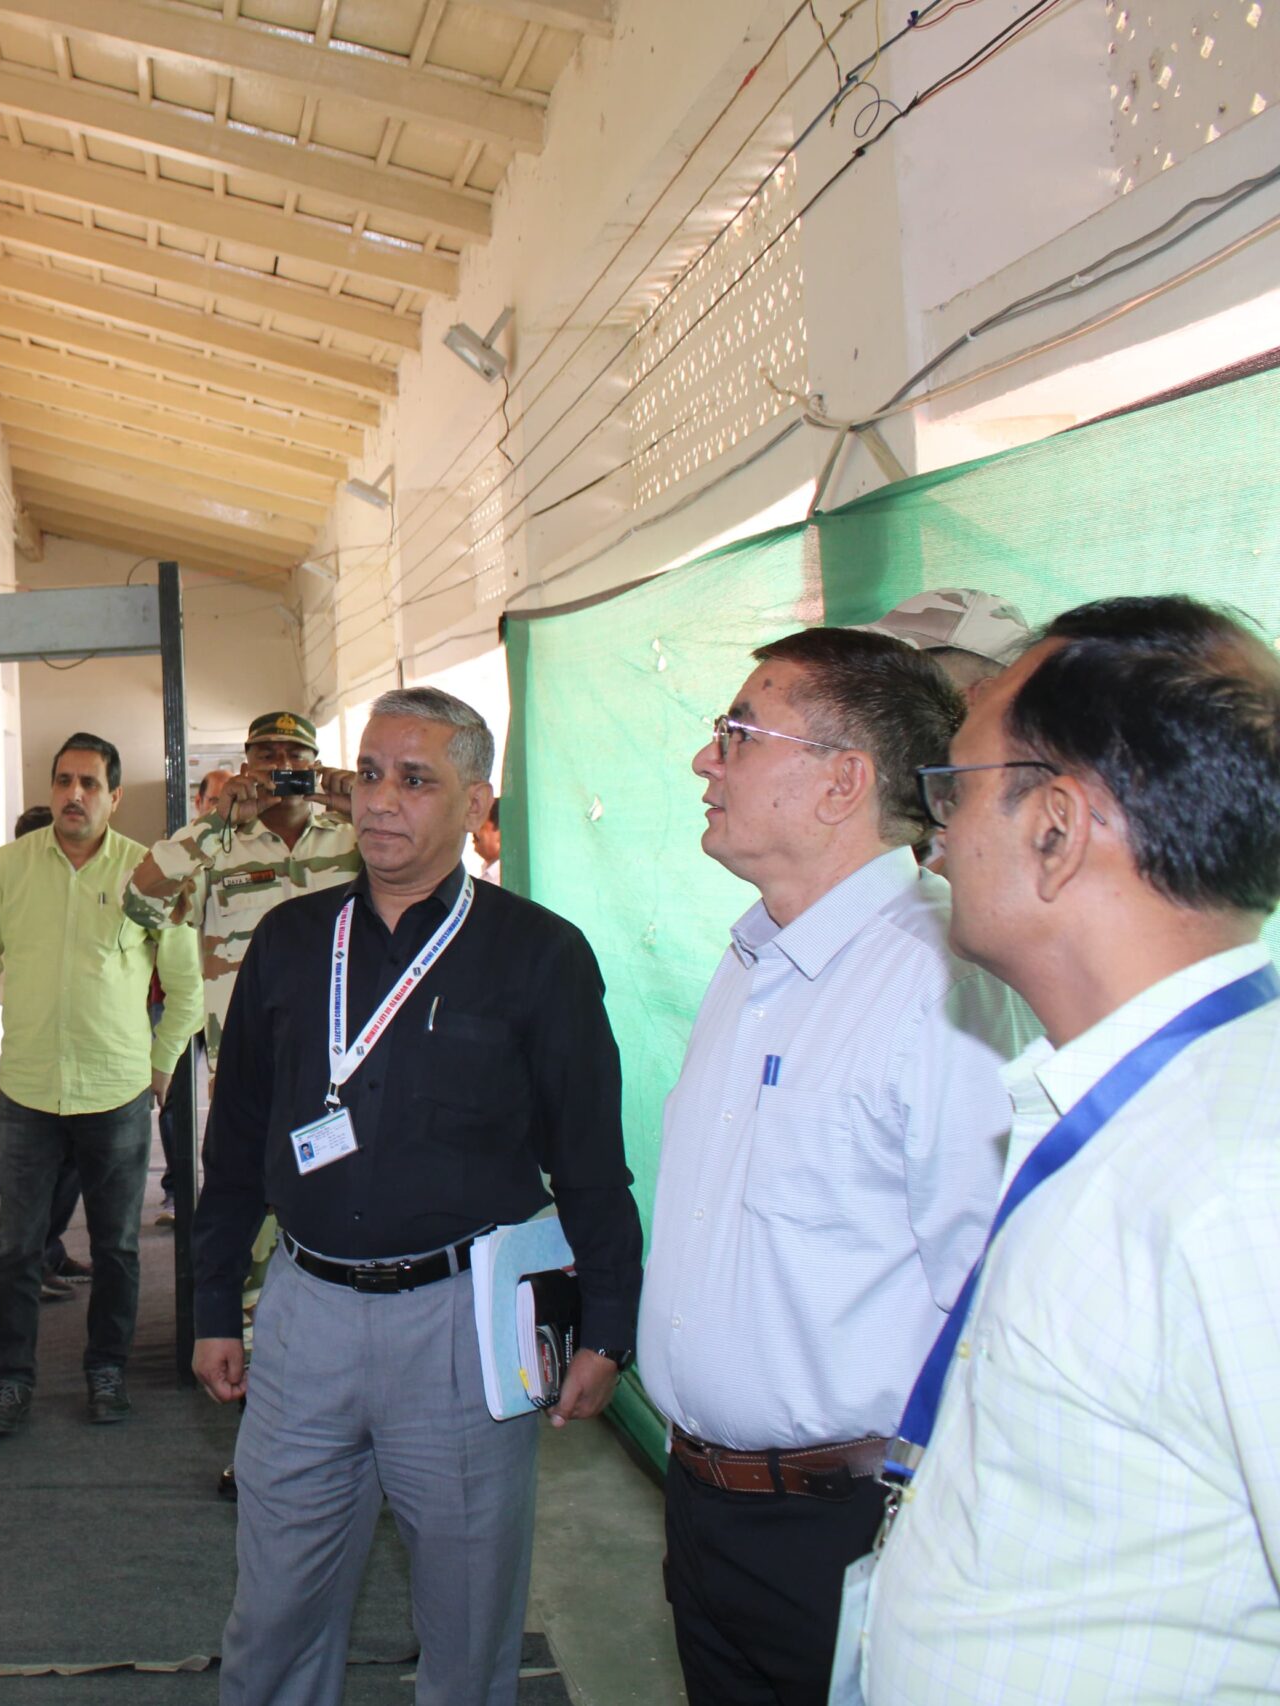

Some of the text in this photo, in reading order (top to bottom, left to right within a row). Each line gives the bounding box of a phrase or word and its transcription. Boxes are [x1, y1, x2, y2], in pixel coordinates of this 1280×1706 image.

[436, 916, 460, 948] COMMISSION
[421, 952, 435, 966] INDIA
[405, 977, 414, 986] NO
[394, 985, 408, 1002] VOTER
[376, 1013, 388, 1025] LEFT
[363, 1024, 380, 1044] BEHIND
